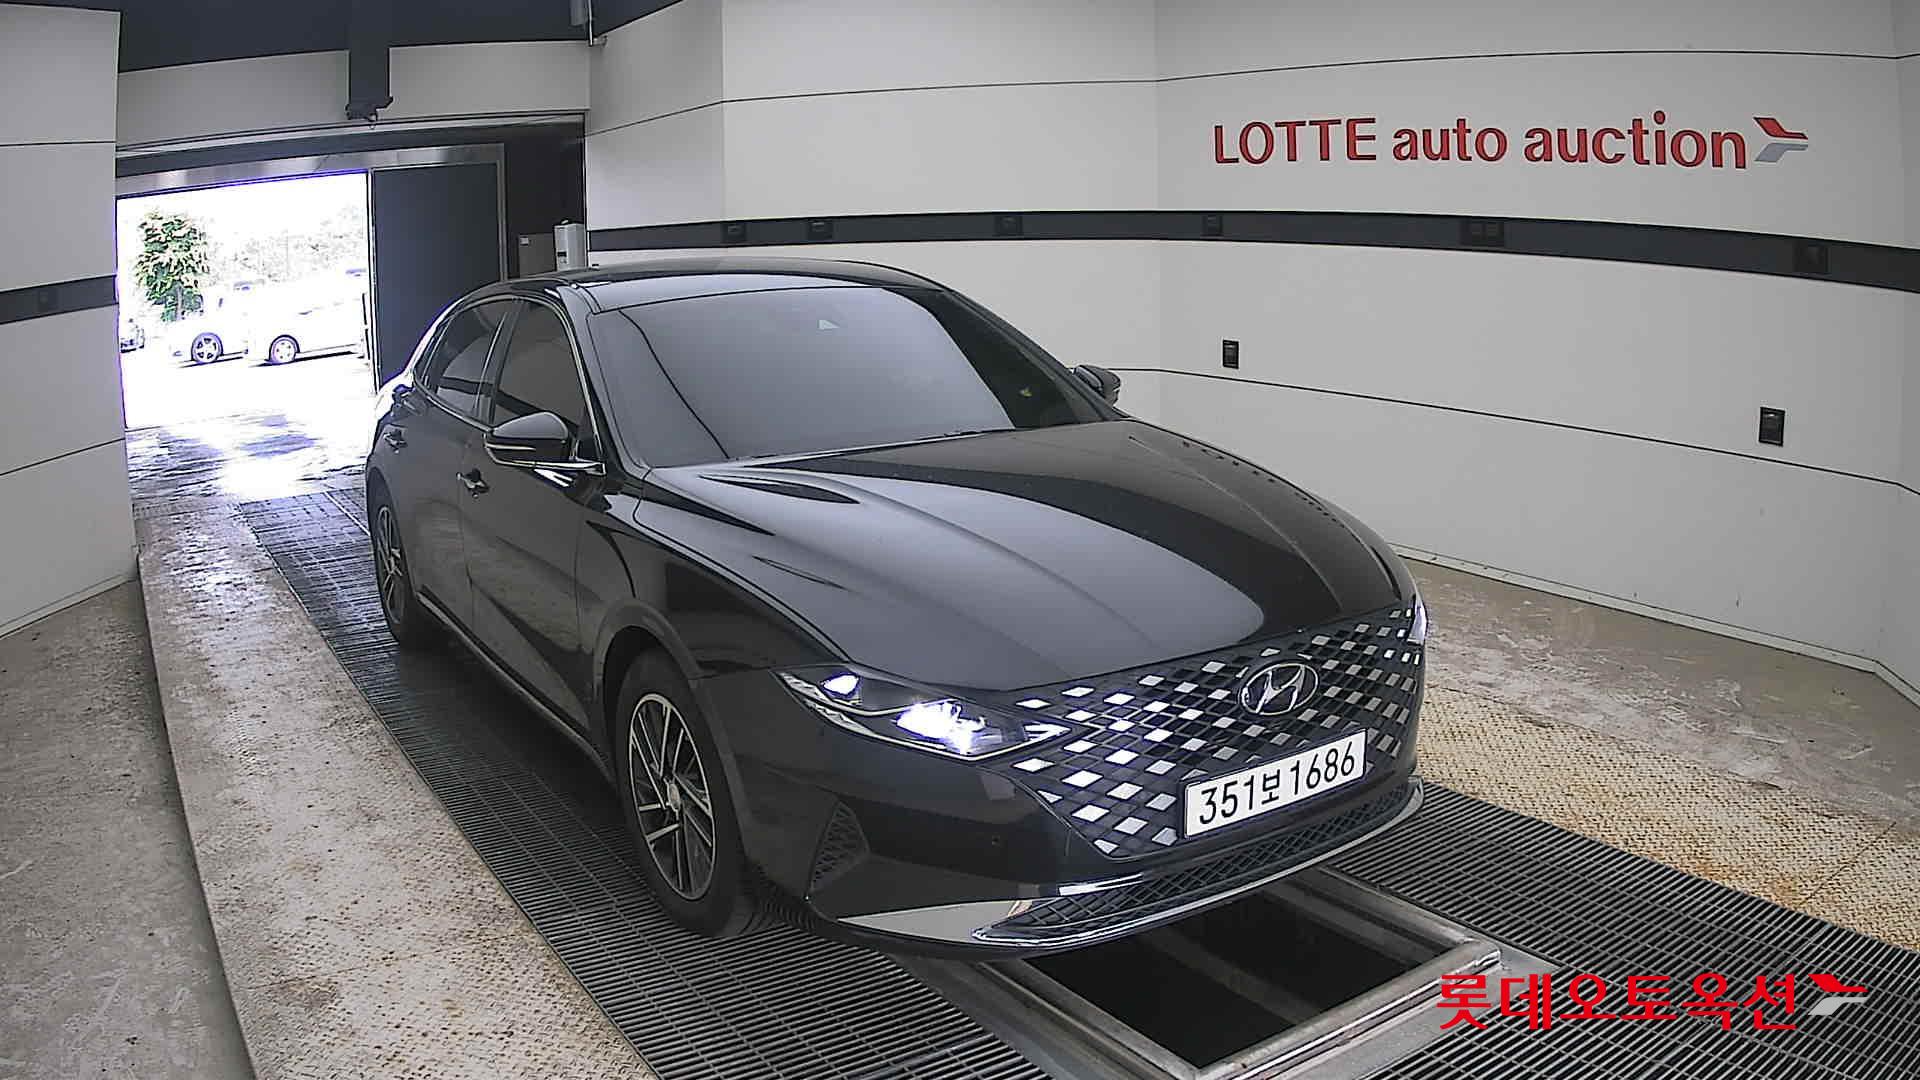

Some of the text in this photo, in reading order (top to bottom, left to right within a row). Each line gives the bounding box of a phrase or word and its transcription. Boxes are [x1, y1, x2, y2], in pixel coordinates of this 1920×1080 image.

[1214, 110, 1748, 169] LOTTE auto auction
